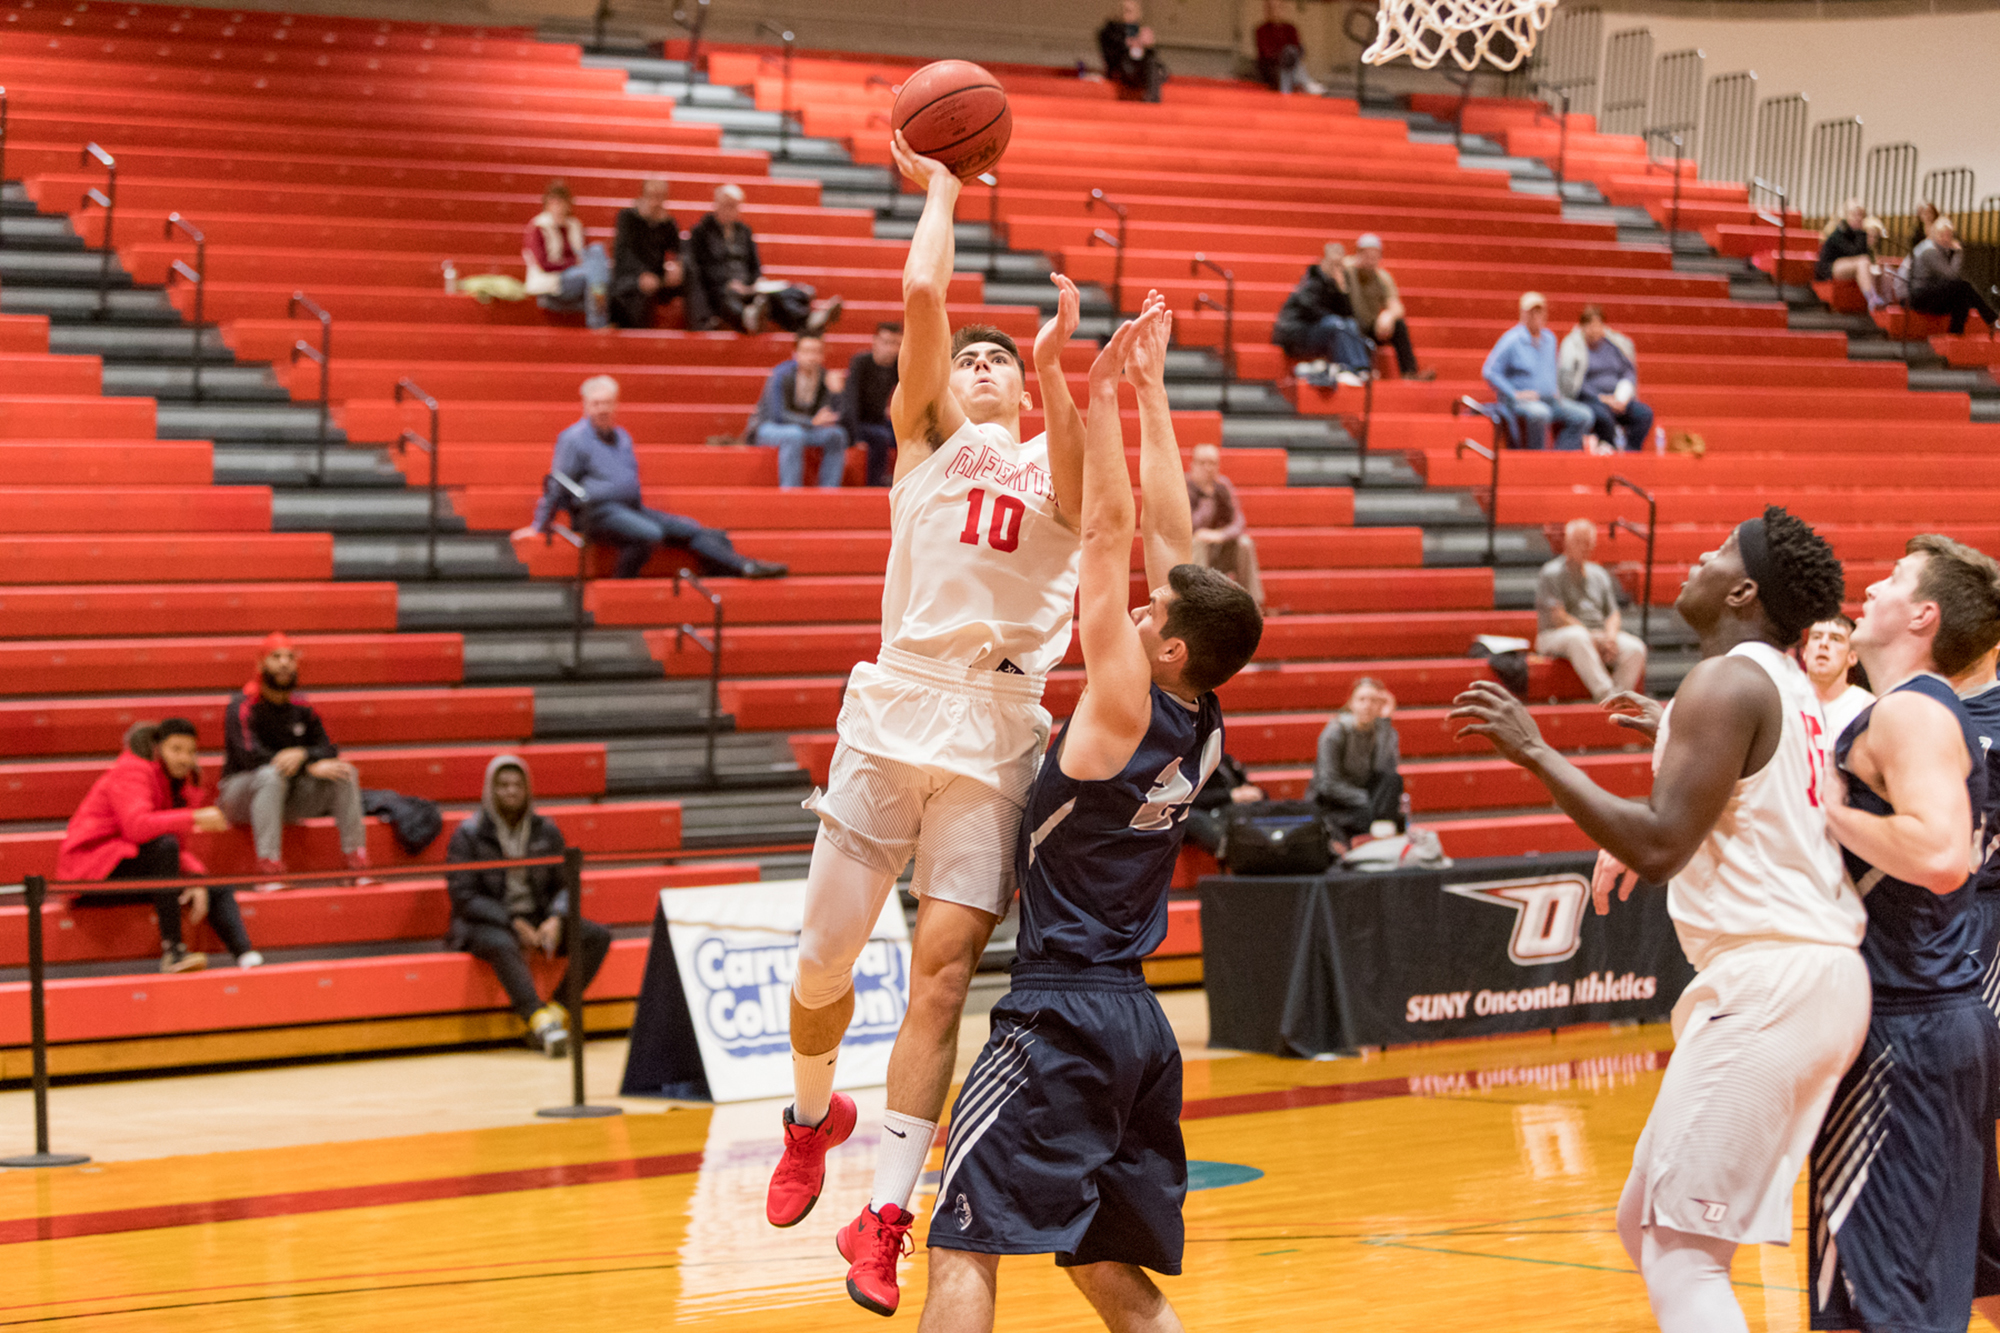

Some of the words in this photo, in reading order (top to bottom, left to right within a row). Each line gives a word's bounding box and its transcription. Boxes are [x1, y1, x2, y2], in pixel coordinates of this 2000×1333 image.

[959, 487, 1026, 553] 10
[1405, 991, 1473, 1022] SUNY
[1473, 981, 1571, 1016] Oneonta
